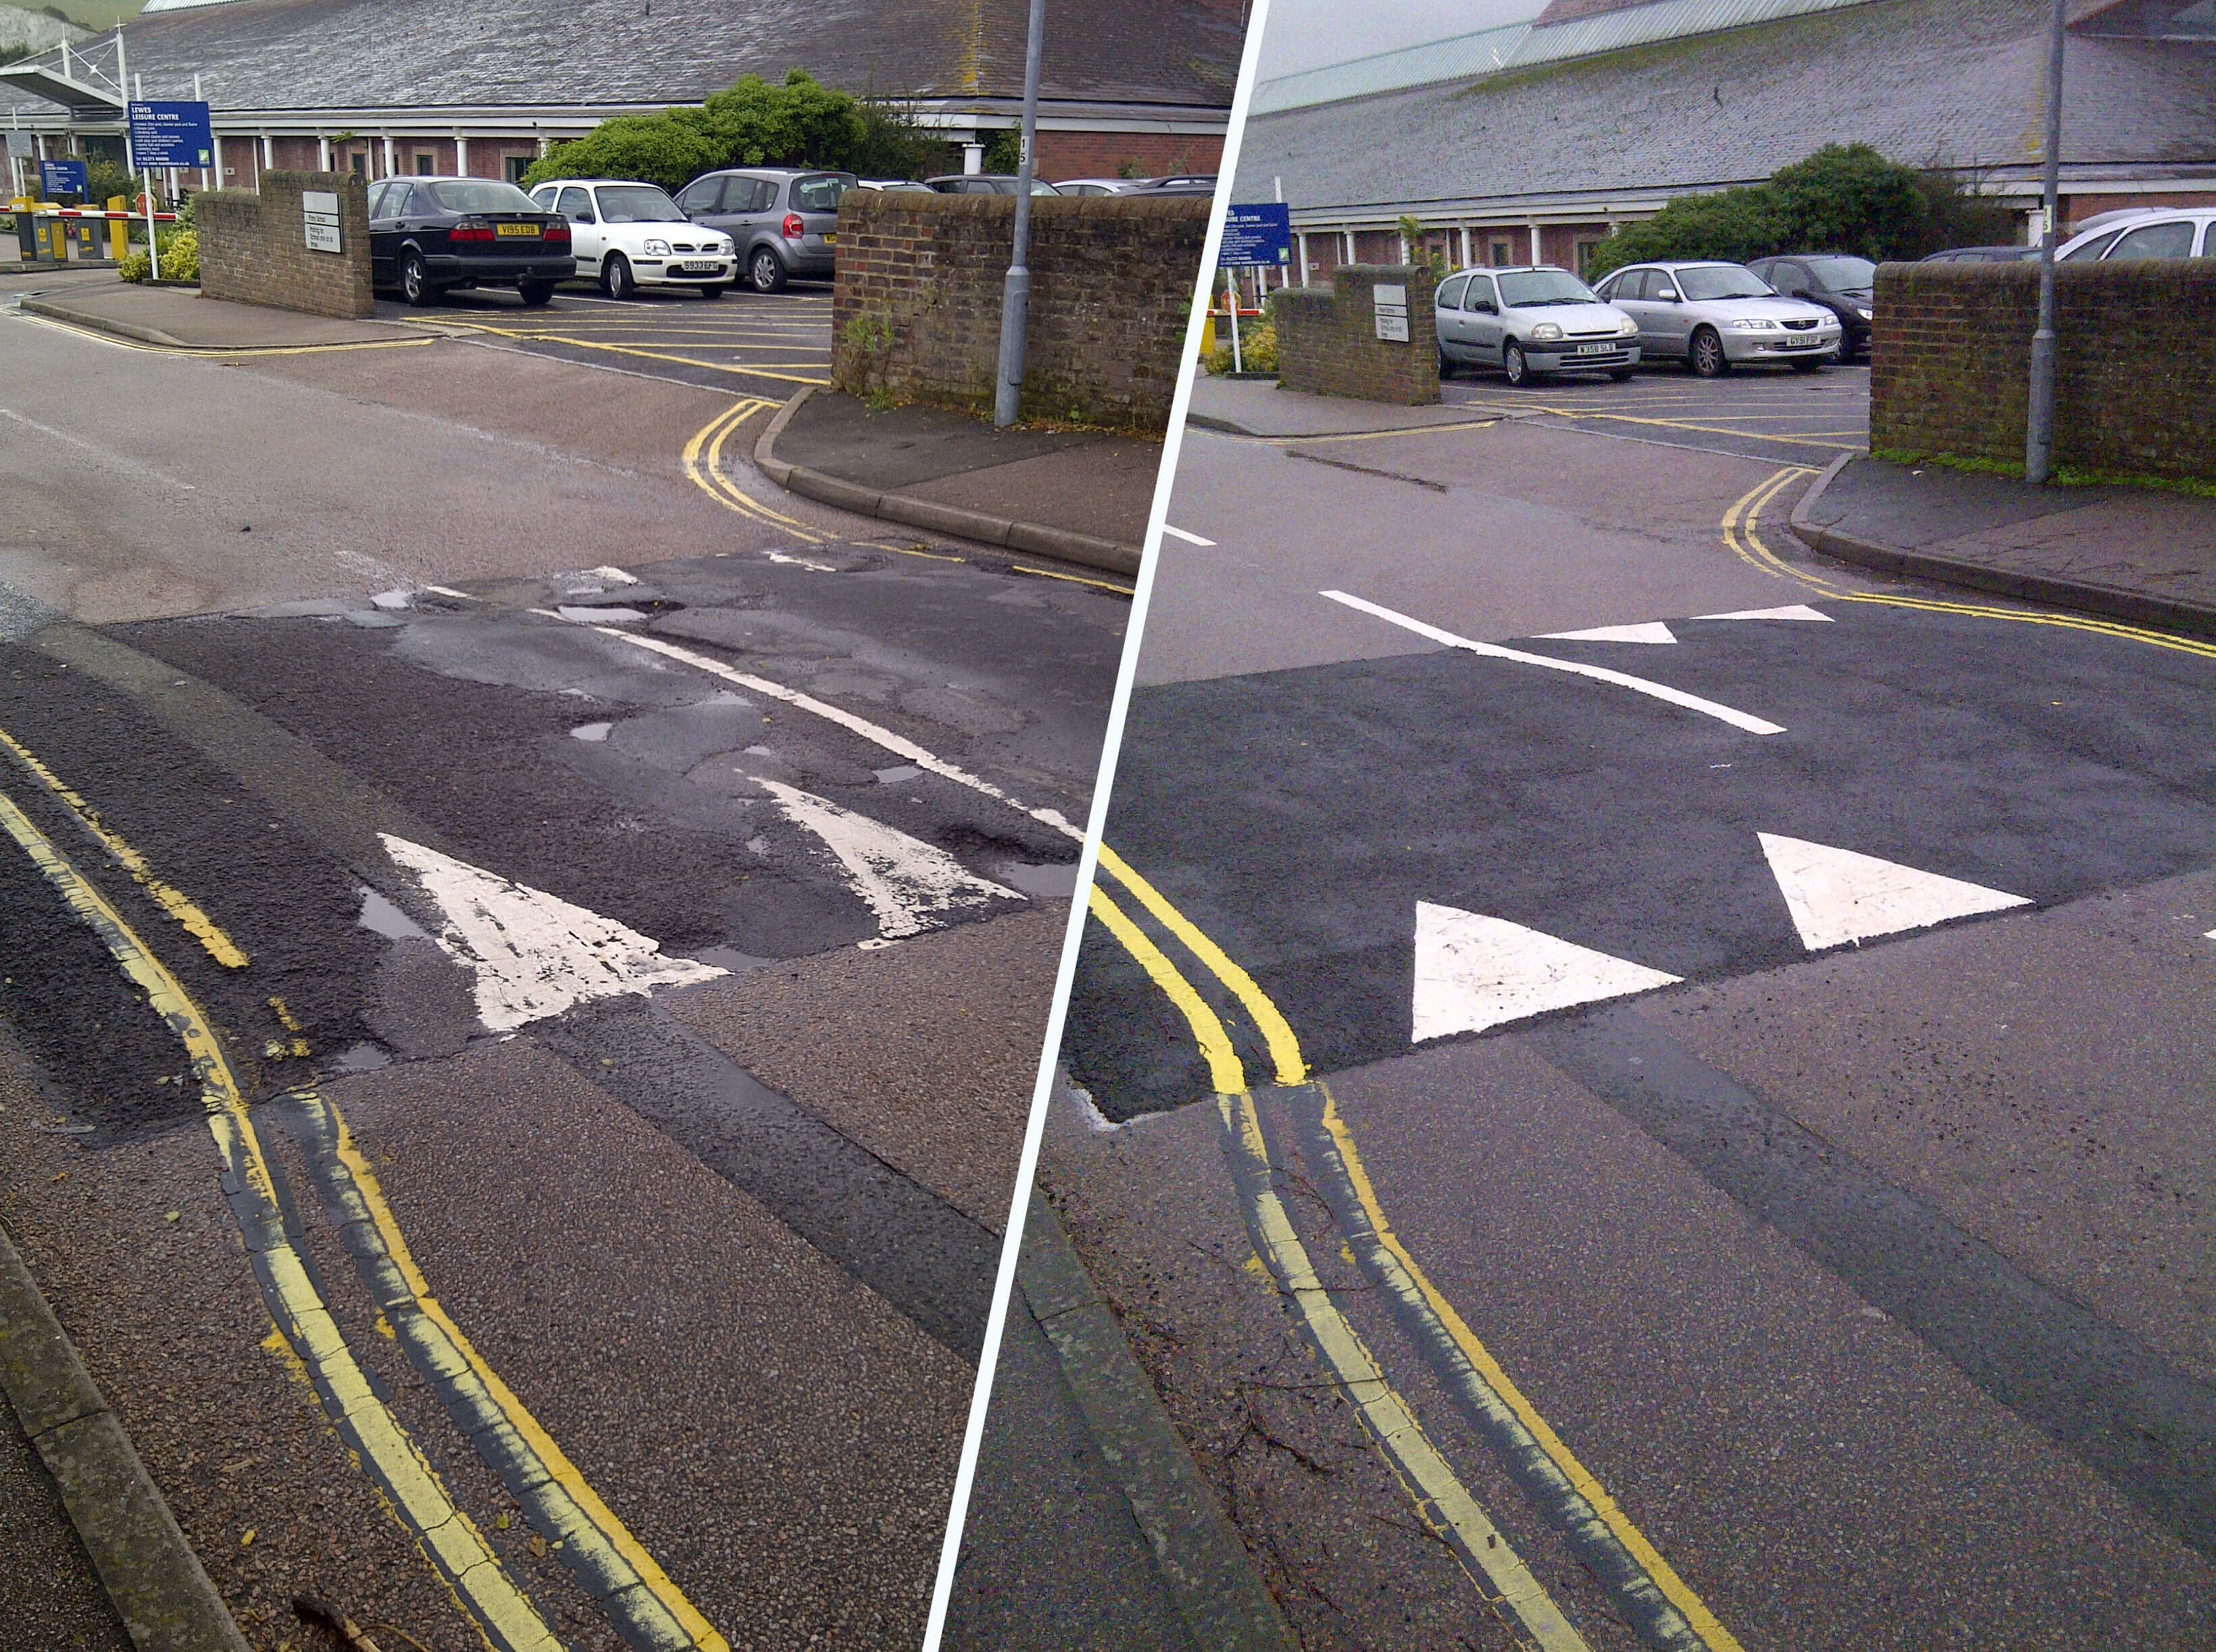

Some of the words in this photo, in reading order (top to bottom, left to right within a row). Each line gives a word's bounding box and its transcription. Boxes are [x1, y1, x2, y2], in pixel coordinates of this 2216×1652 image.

[502, 225, 520, 234] V195
[521, 225, 535, 234] EDB
[685, 261, 703, 270] S933
